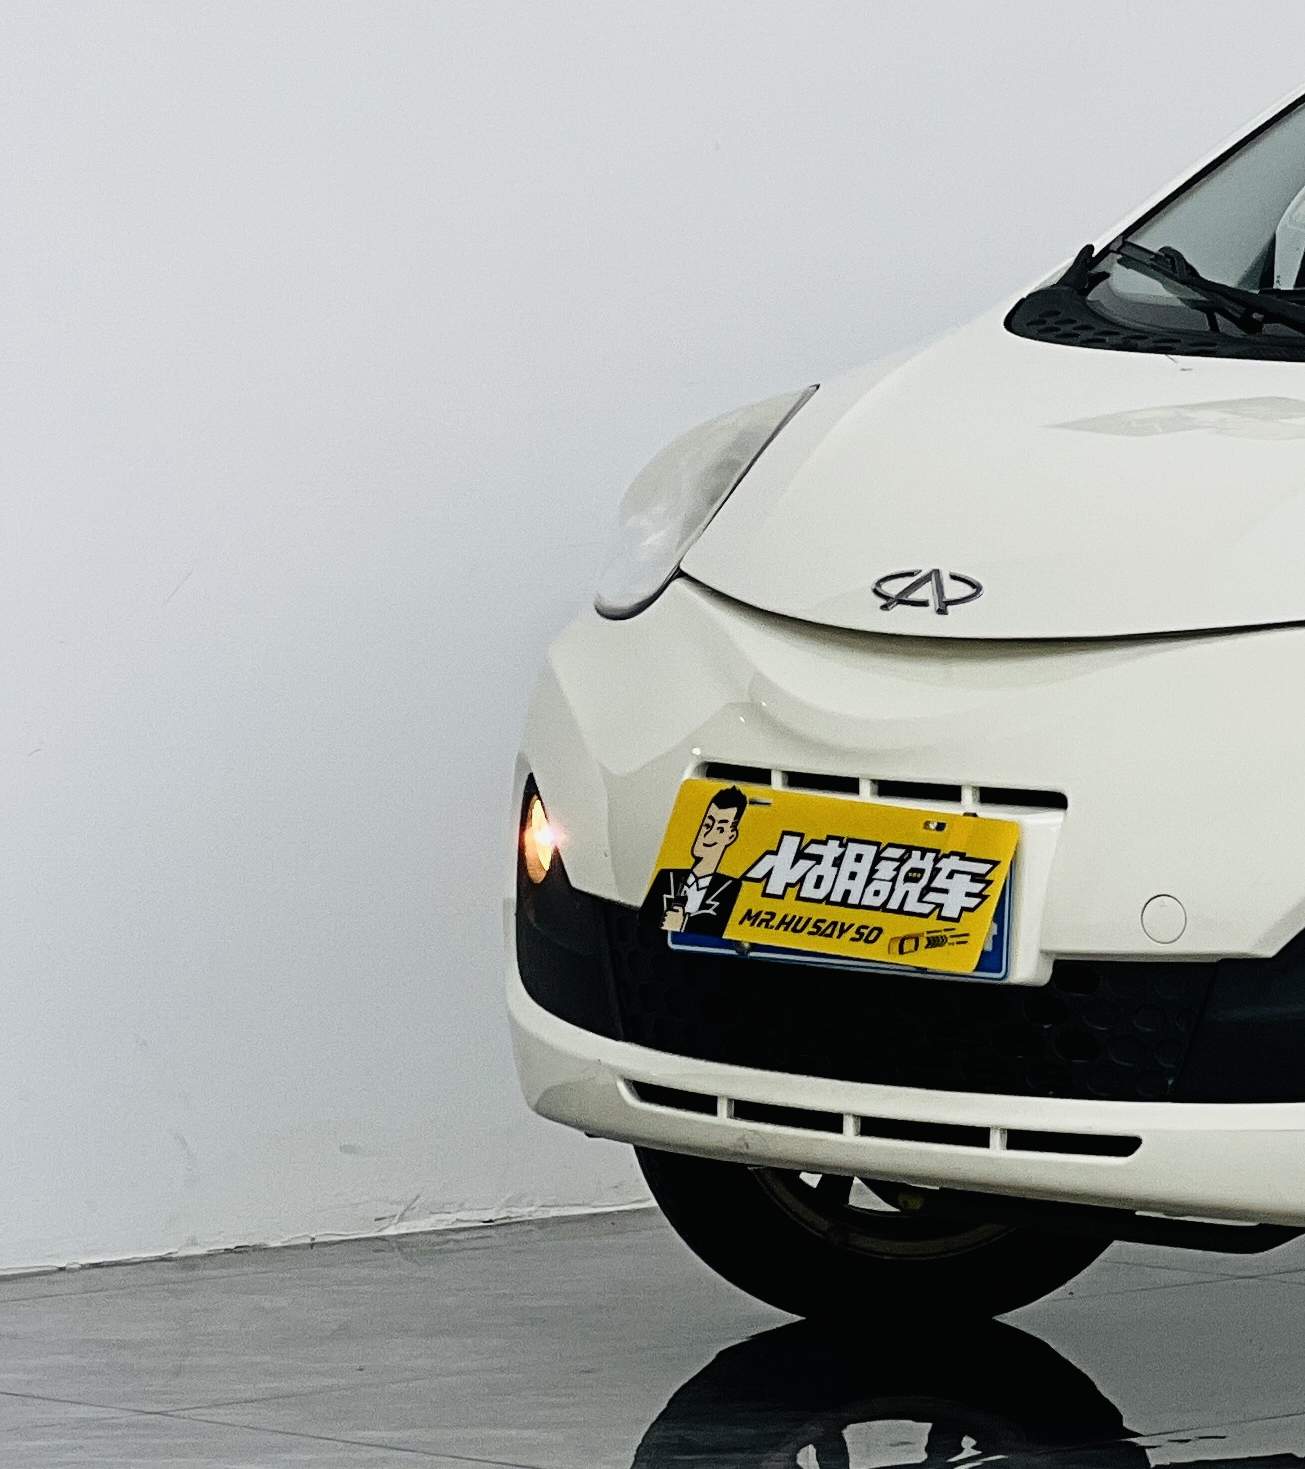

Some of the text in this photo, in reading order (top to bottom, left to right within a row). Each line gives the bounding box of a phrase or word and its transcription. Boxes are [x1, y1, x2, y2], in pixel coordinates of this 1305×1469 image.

[738, 908, 884, 945] MR.HU SAY SO
